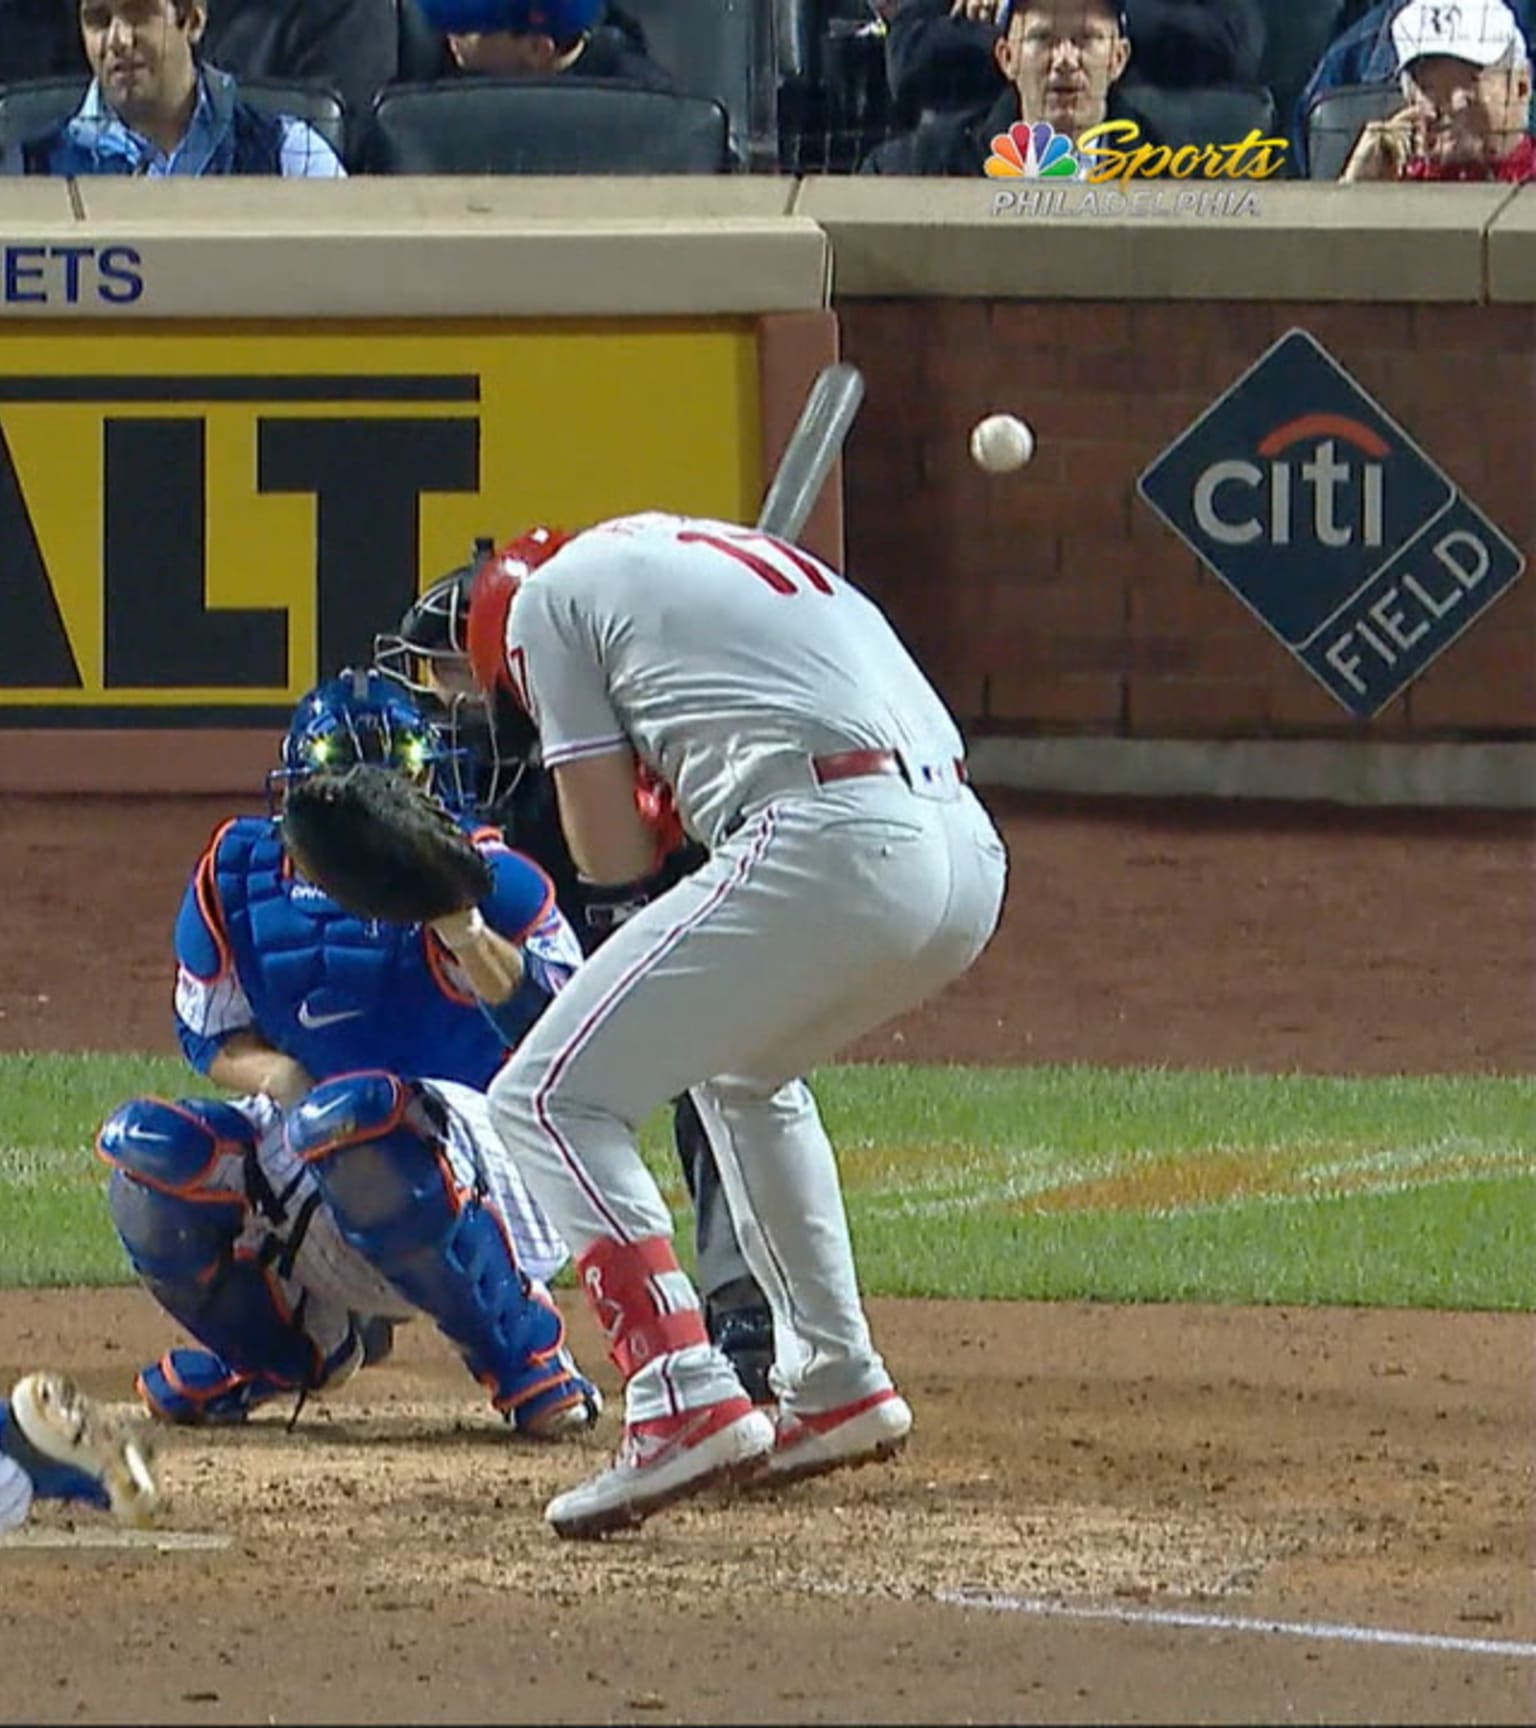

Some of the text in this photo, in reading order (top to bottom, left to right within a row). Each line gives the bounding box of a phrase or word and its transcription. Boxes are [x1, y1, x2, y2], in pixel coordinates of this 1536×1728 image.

[1193, 438, 1384, 548] citi
[675, 530, 835, 597] 17
[1324, 530, 1492, 696] FIELD
